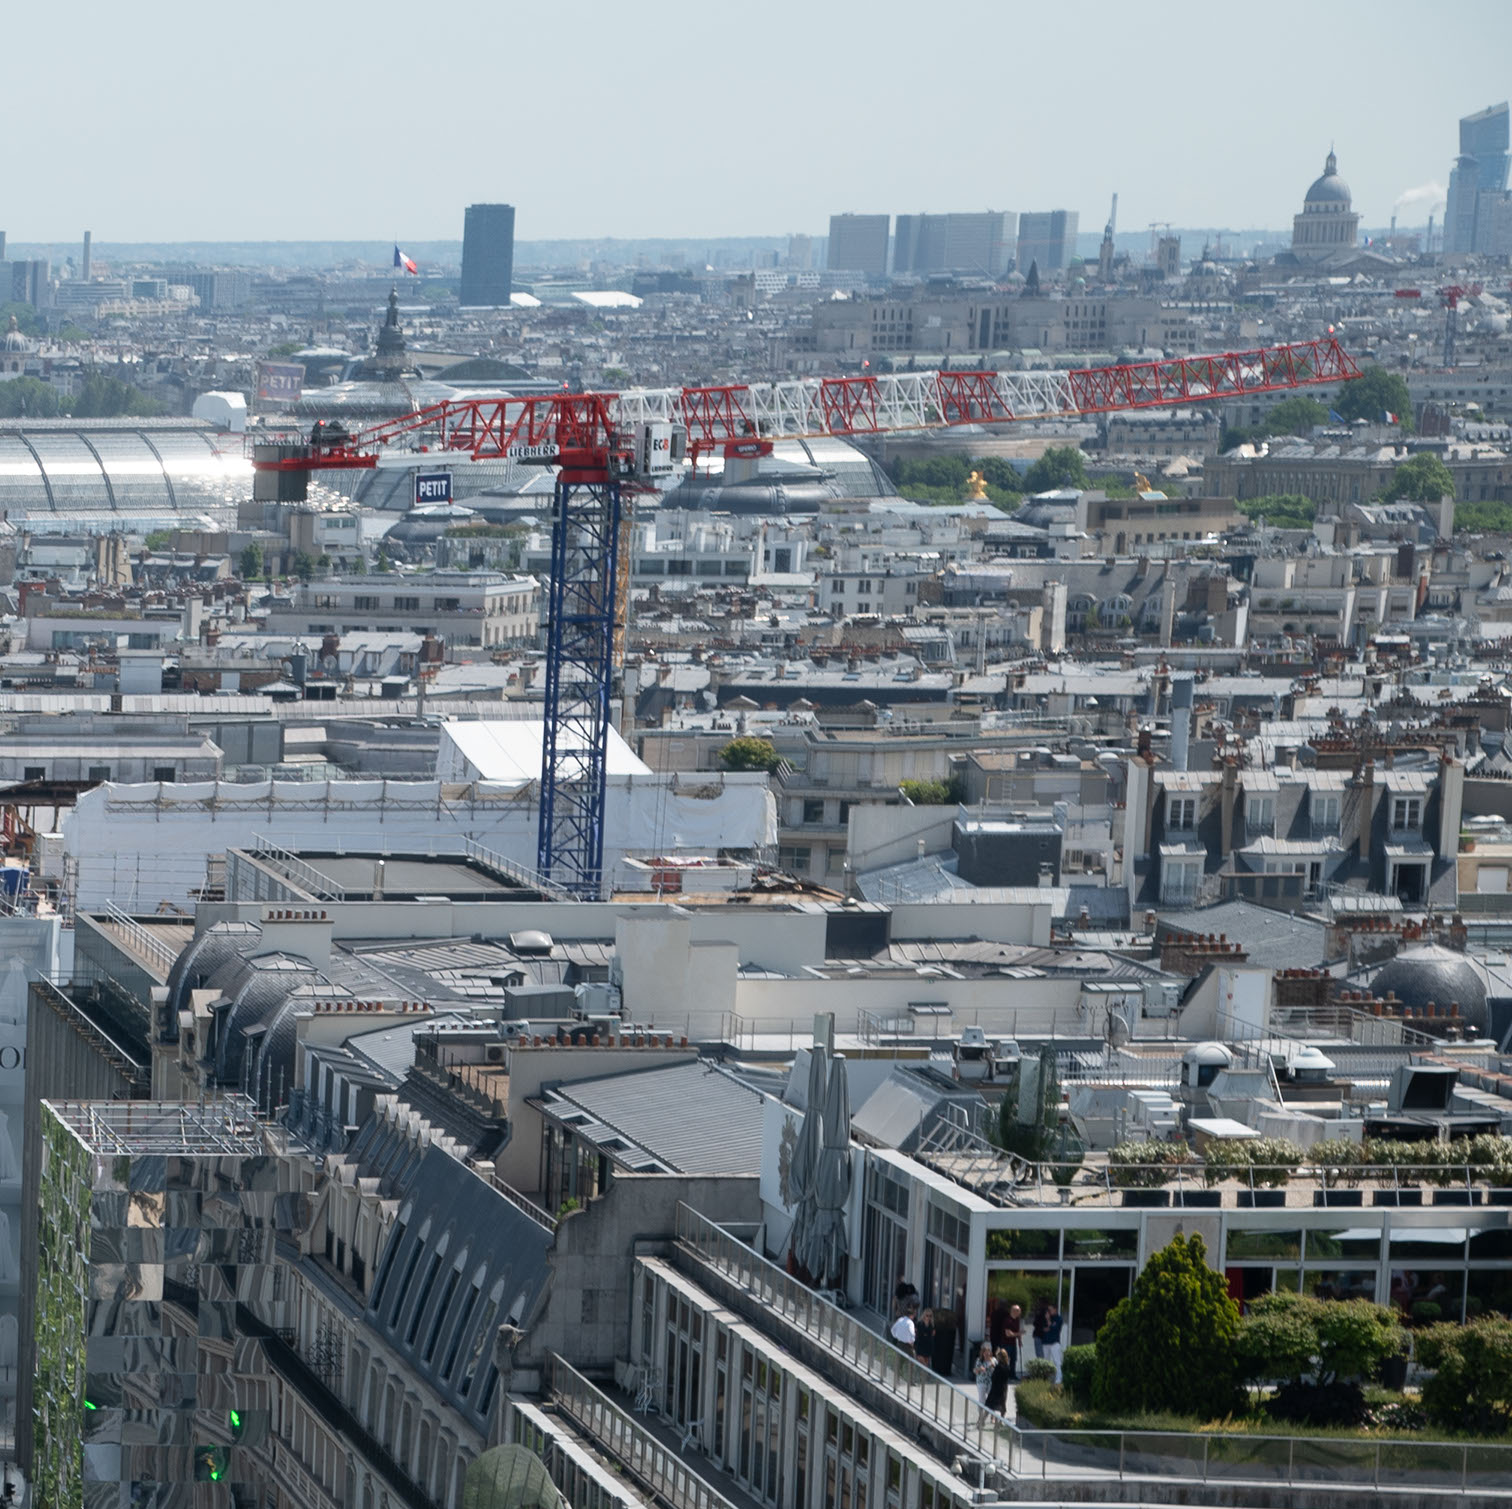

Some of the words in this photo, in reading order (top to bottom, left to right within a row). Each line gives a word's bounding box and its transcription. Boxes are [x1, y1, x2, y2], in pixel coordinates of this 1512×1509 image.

[260, 375, 301, 389] PETIT
[509, 445, 557, 457] LIEBHERR
[419, 480, 448, 497] PETIT
